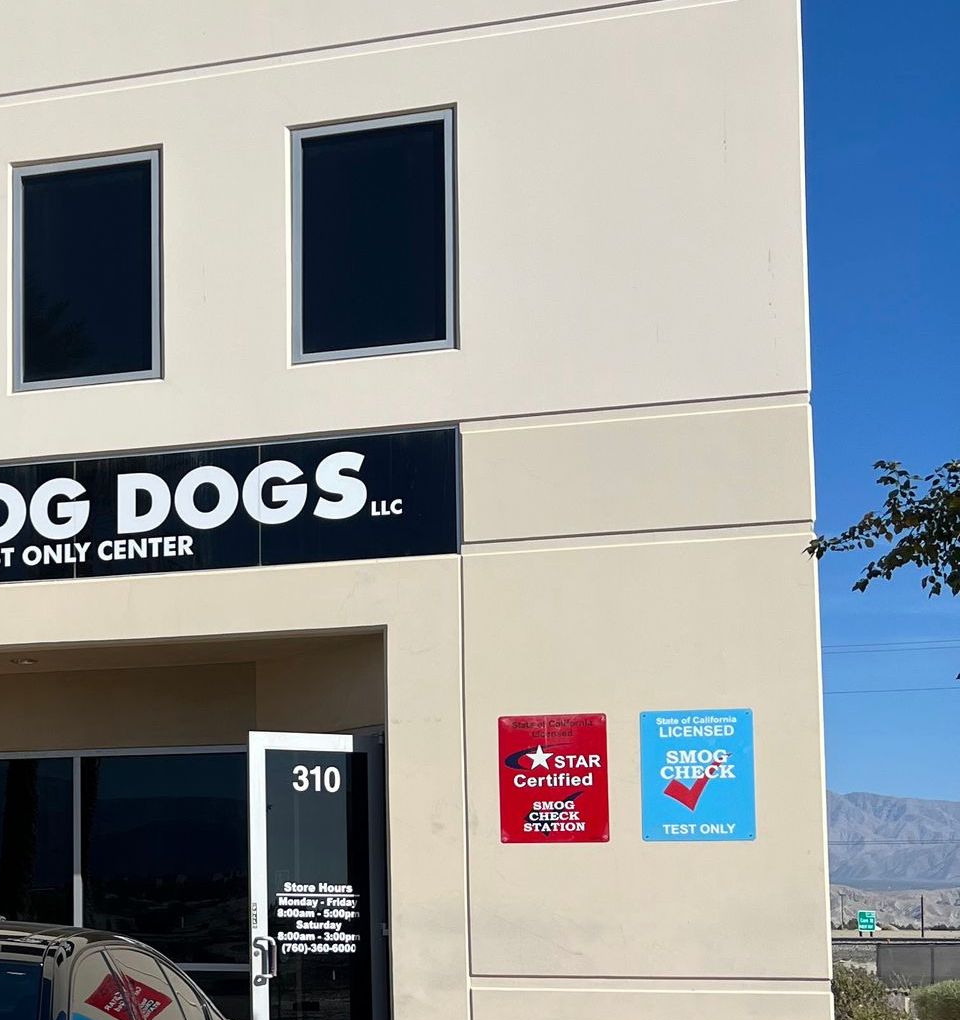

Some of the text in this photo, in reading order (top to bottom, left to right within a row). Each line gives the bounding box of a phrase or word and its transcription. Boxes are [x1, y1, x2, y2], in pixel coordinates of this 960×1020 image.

[117, 451, 367, 534] DOGS
[371, 499, 403, 516] LLC
[22, 542, 91, 566] ONLY
[97, 536, 194, 561] CENTER
[656, 717, 679, 725] State
[692, 716, 737, 724] California
[659, 725, 735, 738] LICENSED
[554, 754, 601, 769] STAR
[666, 749, 728, 764] SMOG
[660, 765, 736, 779] CHECK
[292, 765, 341, 793] 310
[513, 772, 593, 788] Certified
[532, 800, 575, 811] SMOG
[528, 811, 580, 821] CHECK
[523, 822, 586, 832] STATION
[662, 823, 736, 834] TEST ONLY
[283, 882, 353, 893] Store Hours
[278, 897, 318, 909] Monday
[326, 897, 358, 909] Friday
[276, 908, 315, 918] 8:00am
[295, 920, 342, 932] Saturday
[277, 931, 316, 941] 8:00am
[281, 943, 357, 955] (760)-360-6000
